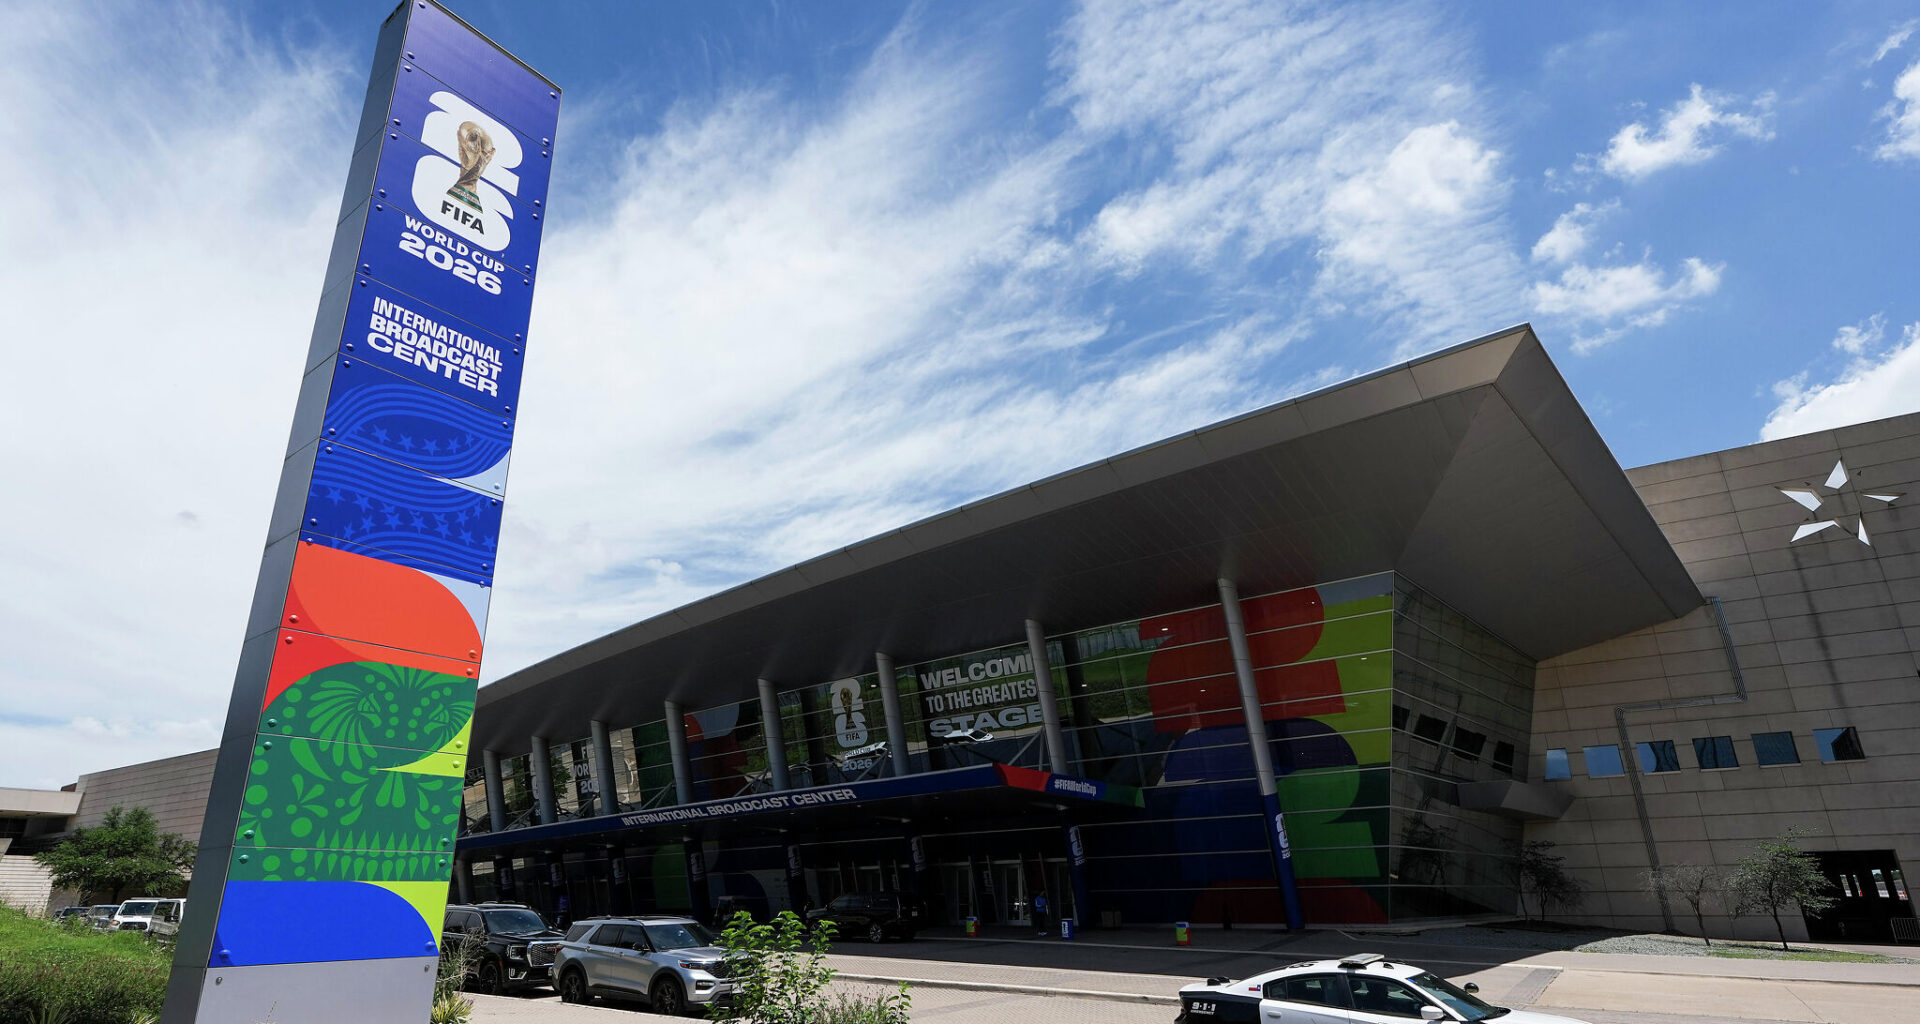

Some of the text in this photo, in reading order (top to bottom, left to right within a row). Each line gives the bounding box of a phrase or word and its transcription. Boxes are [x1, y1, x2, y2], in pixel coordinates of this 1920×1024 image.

[441, 200, 485, 236] FIFA
[405, 214, 505, 274] WORLD CUP
[399, 232, 503, 296] 2026
[369, 313, 502, 382] BROADCAST
[373, 296, 503, 367] INTERNATIONAL
[367, 332, 499, 398] CENTER
[925, 678, 1038, 713] TO THE GREATES
[845, 732, 860, 742] FIFA
[929, 704, 1044, 738] STAGE
[842, 758, 873, 772] 2026
[1053, 778, 1097, 797] #FIFAWorldCup
[621, 788, 857, 827] INTERNATIONAL BROADCAST CENTER
